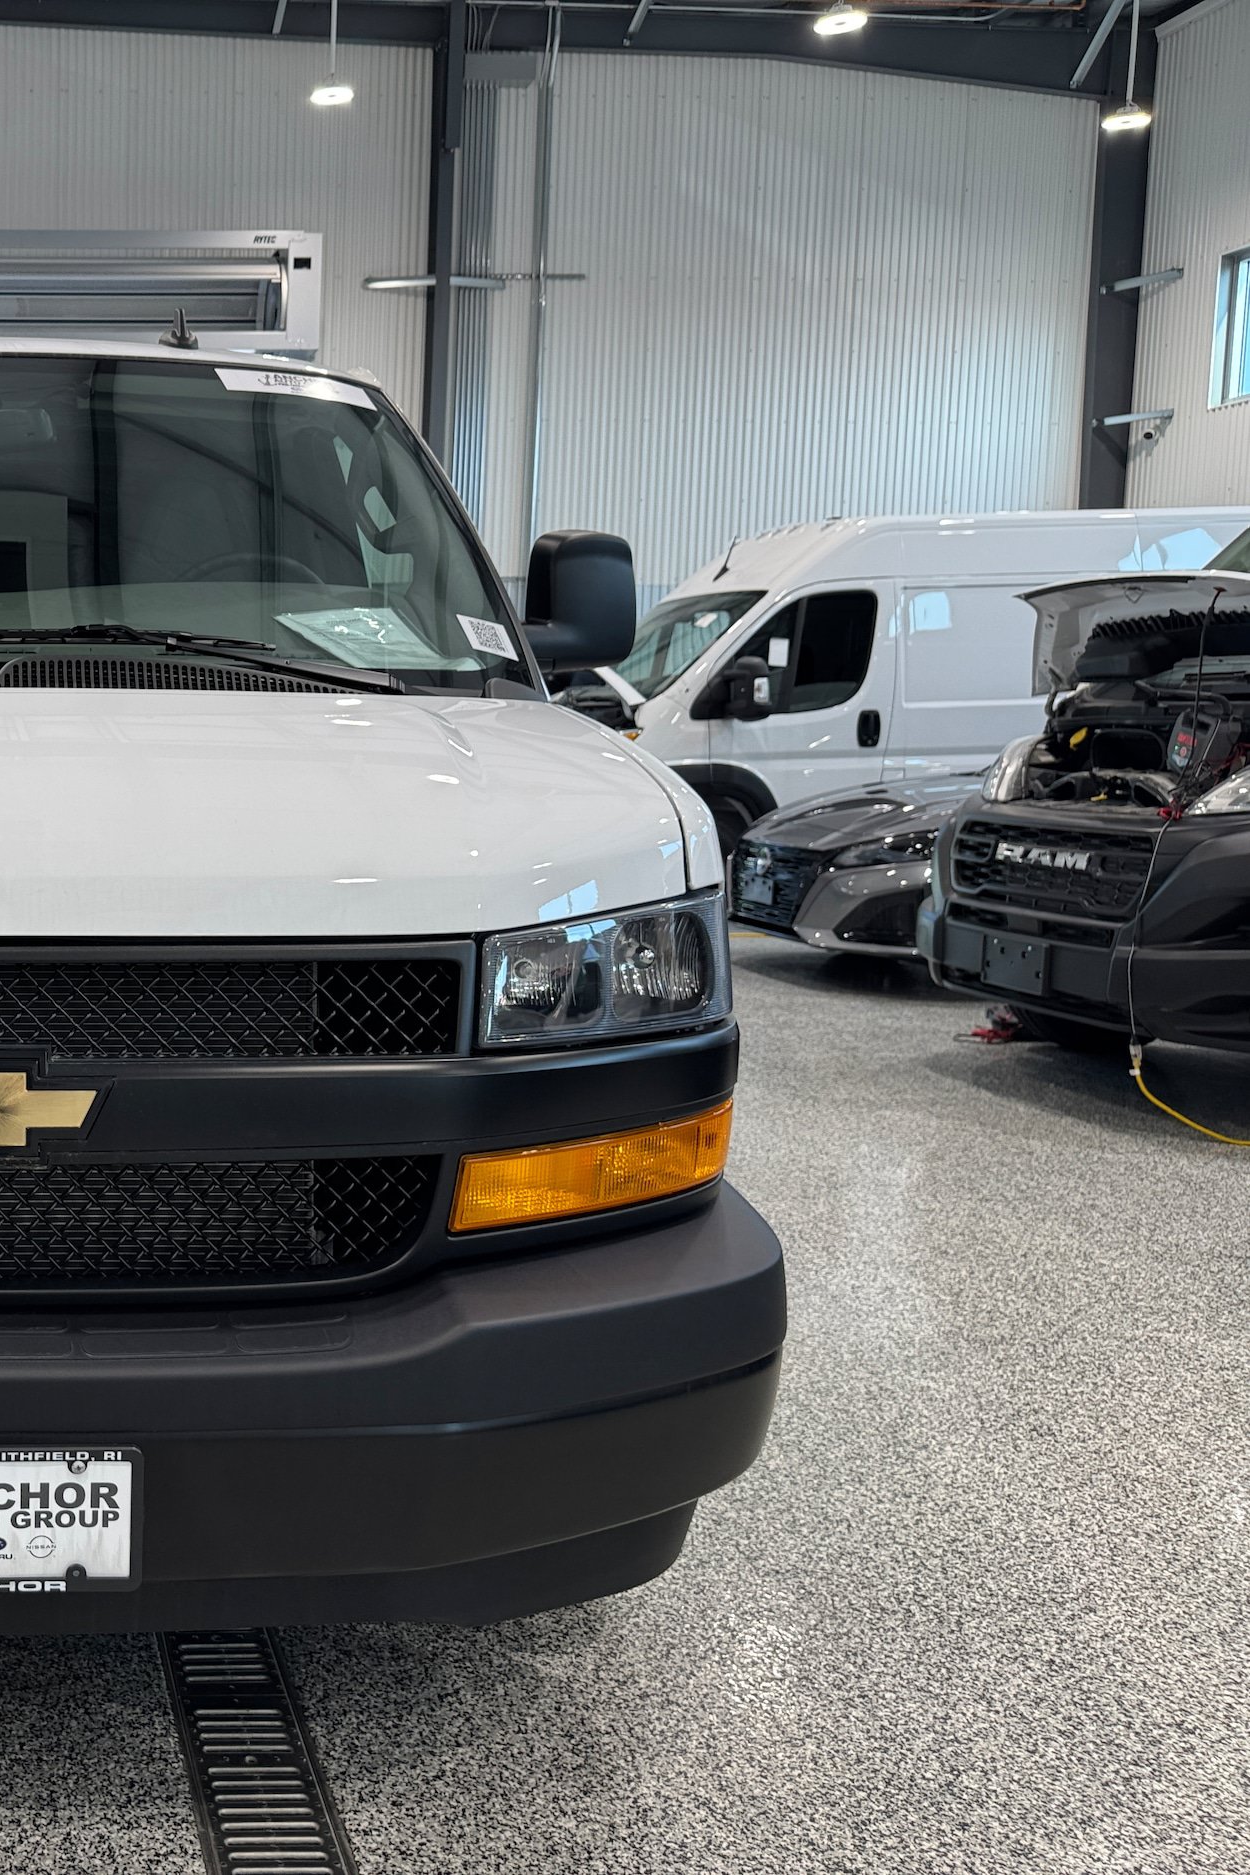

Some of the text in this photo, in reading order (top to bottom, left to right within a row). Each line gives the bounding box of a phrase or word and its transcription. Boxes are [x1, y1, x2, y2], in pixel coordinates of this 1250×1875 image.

[995, 842, 1091, 871] RAM
[103, 1450, 122, 1461] RI
[10, 1509, 120, 1529] GROUP
